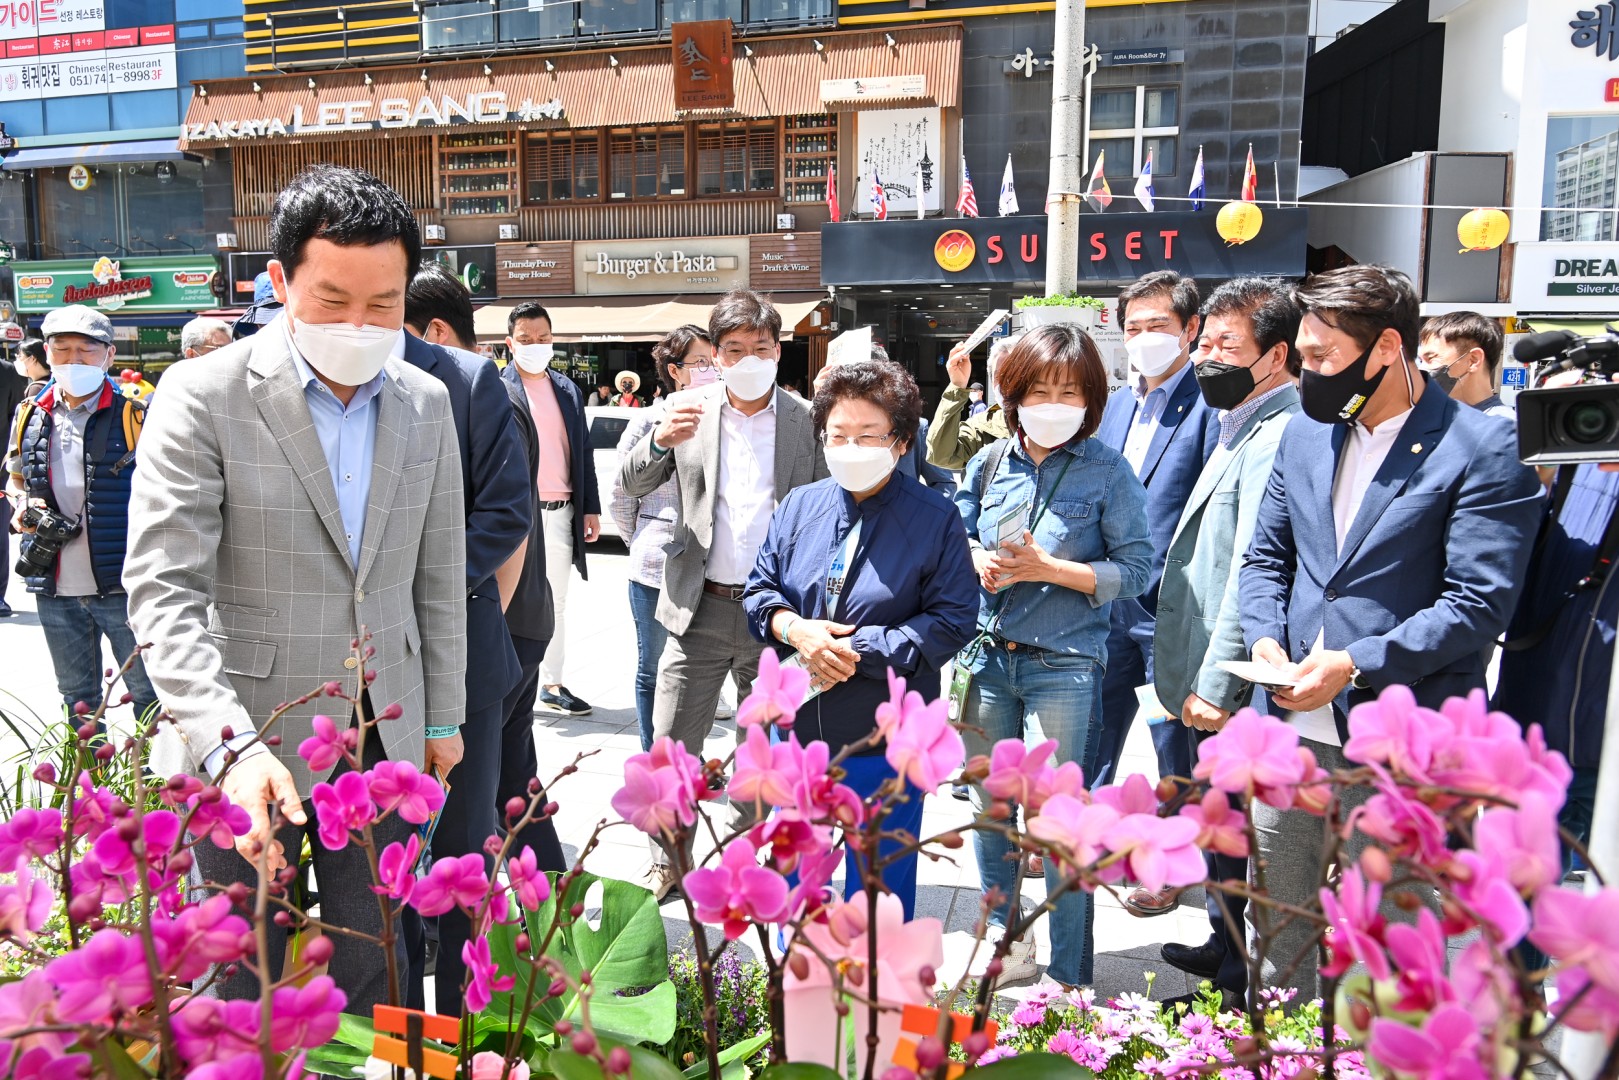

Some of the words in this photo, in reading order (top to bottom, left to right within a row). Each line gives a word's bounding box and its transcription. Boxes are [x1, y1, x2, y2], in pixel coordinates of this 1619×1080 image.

[76, 8, 103, 20] 레스토랑
[69, 64, 106, 74] Chinese
[108, 59, 162, 71] Restaurant
[682, 94, 700, 102] LEE
[701, 93, 727, 101] SANG
[180, 117, 287, 141] IZAKAYA
[294, 100, 372, 132] LEE
[379, 91, 507, 129] SANG
[986, 230, 1179, 264] SUSET
[761, 252, 784, 261] Music
[502, 259, 537, 269] Thursday
[537, 259, 557, 269] Party
[596, 252, 652, 280] Burger
[653, 250, 670, 274] &
[671, 250, 717, 273] Pasta
[762, 263, 782, 272] Draft
[782, 263, 790, 271] &
[790, 263, 810, 271] Wine
[508, 271, 530, 280] Burger
[530, 270, 552, 279] House
[1576, 284, 1606, 294] Silver
